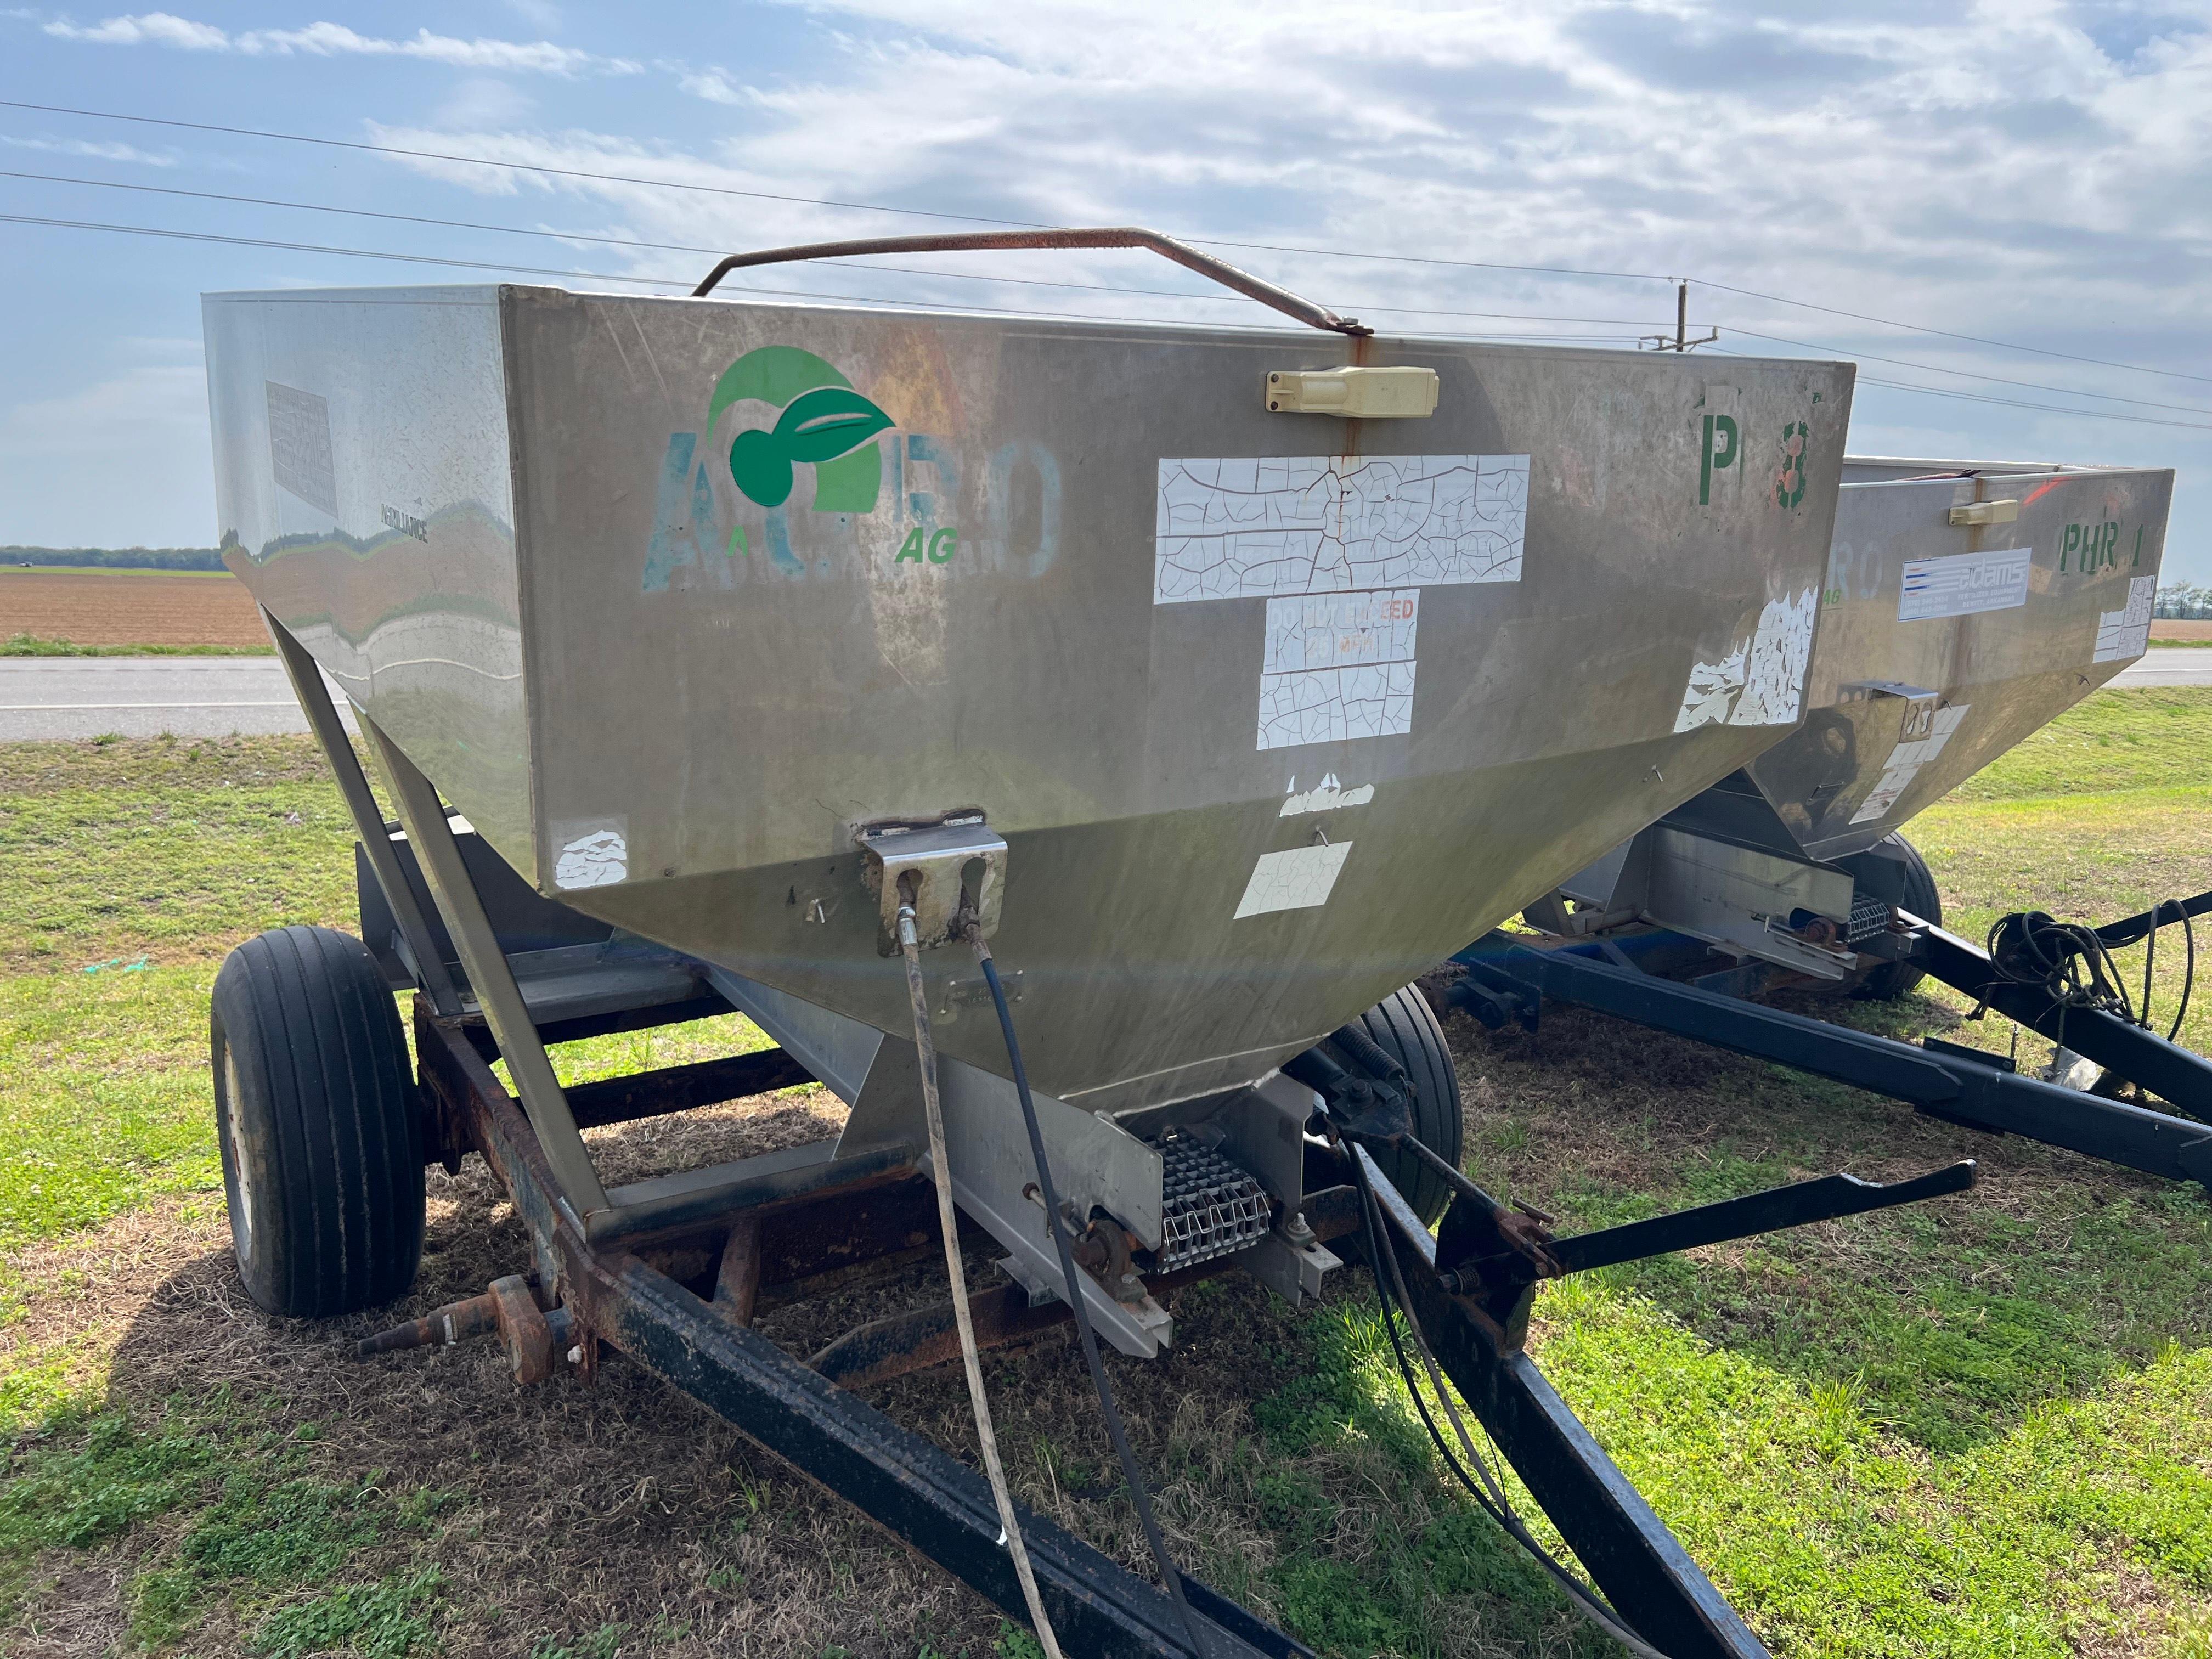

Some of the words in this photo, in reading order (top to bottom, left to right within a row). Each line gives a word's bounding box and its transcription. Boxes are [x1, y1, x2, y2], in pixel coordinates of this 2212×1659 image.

[642, 431, 1063, 592] ARO
[894, 527, 958, 563] AG
[2059, 522, 2119, 572] PHR
[2132, 523, 2144, 567] 1
[1823, 589, 1842, 605] AG
